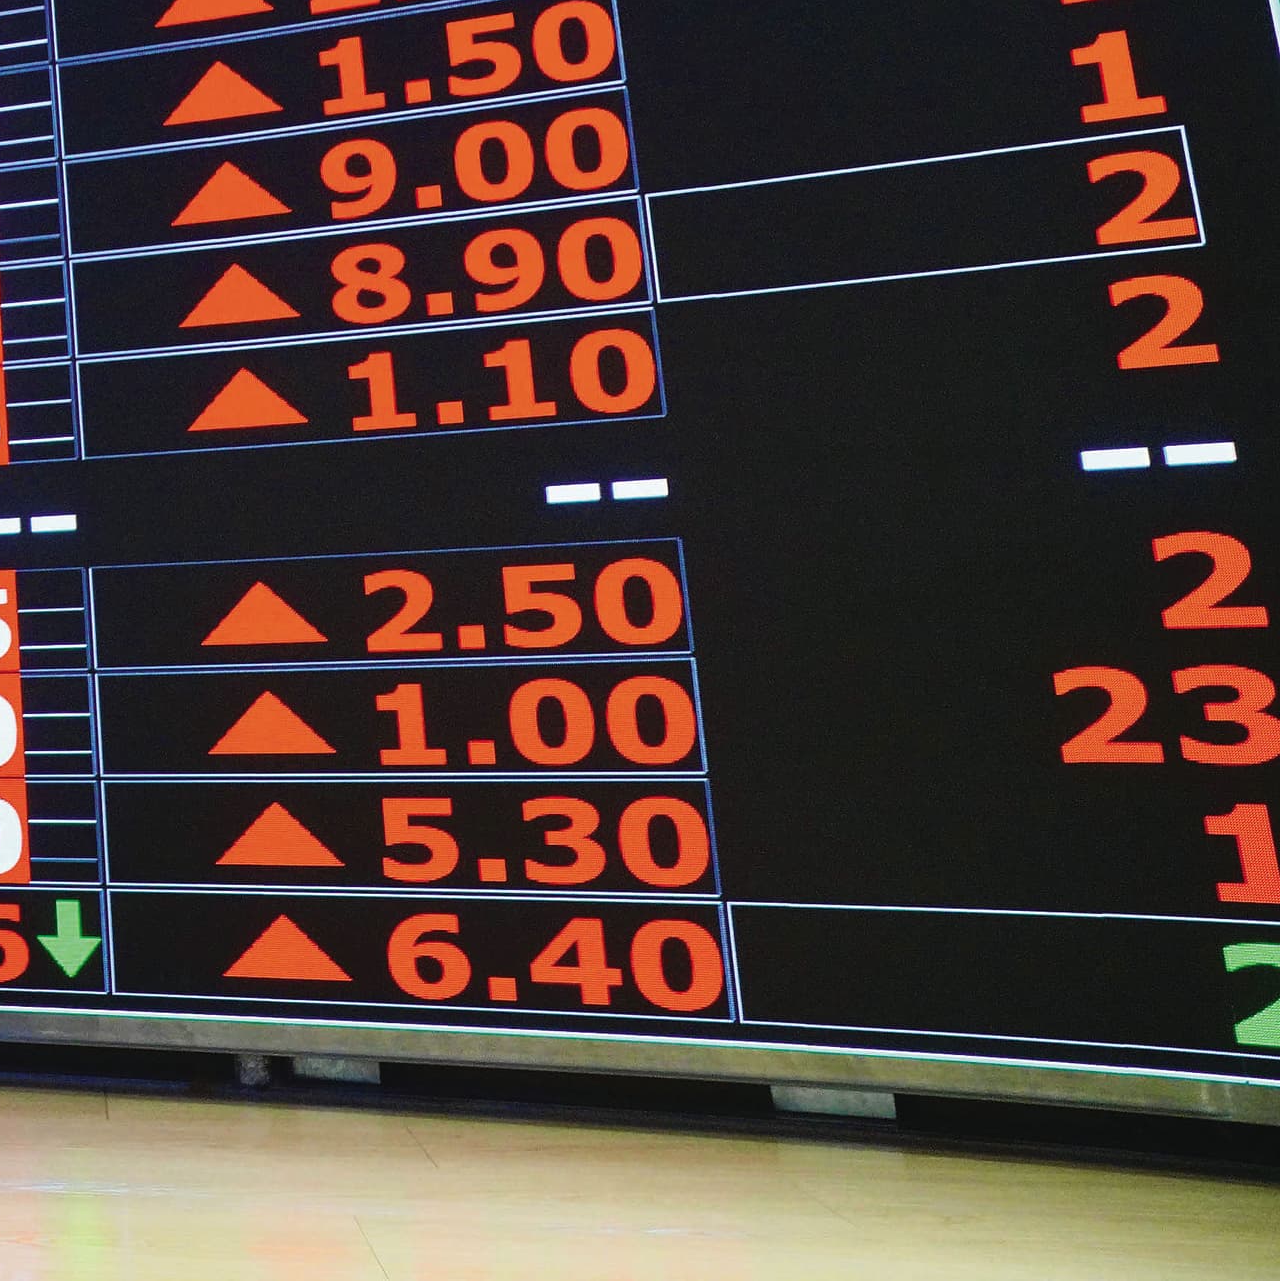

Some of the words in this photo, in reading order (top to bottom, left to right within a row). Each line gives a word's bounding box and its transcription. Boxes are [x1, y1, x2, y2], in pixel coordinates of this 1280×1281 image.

[319, 0, 615, 115] 1.50
[320, 108, 628, 219] 9.00
[1087, 151, 1197, 245] 2
[331, 217, 642, 324] 8.90
[348, 329, 655, 431] 1.10
[364, 558, 682, 652] 2.50
[376, 676, 696, 765] 1.00
[1053, 665, 1280, 765] 23
[382, 796, 709, 887] 5.30
[387, 914, 723, 1011] 6.40
